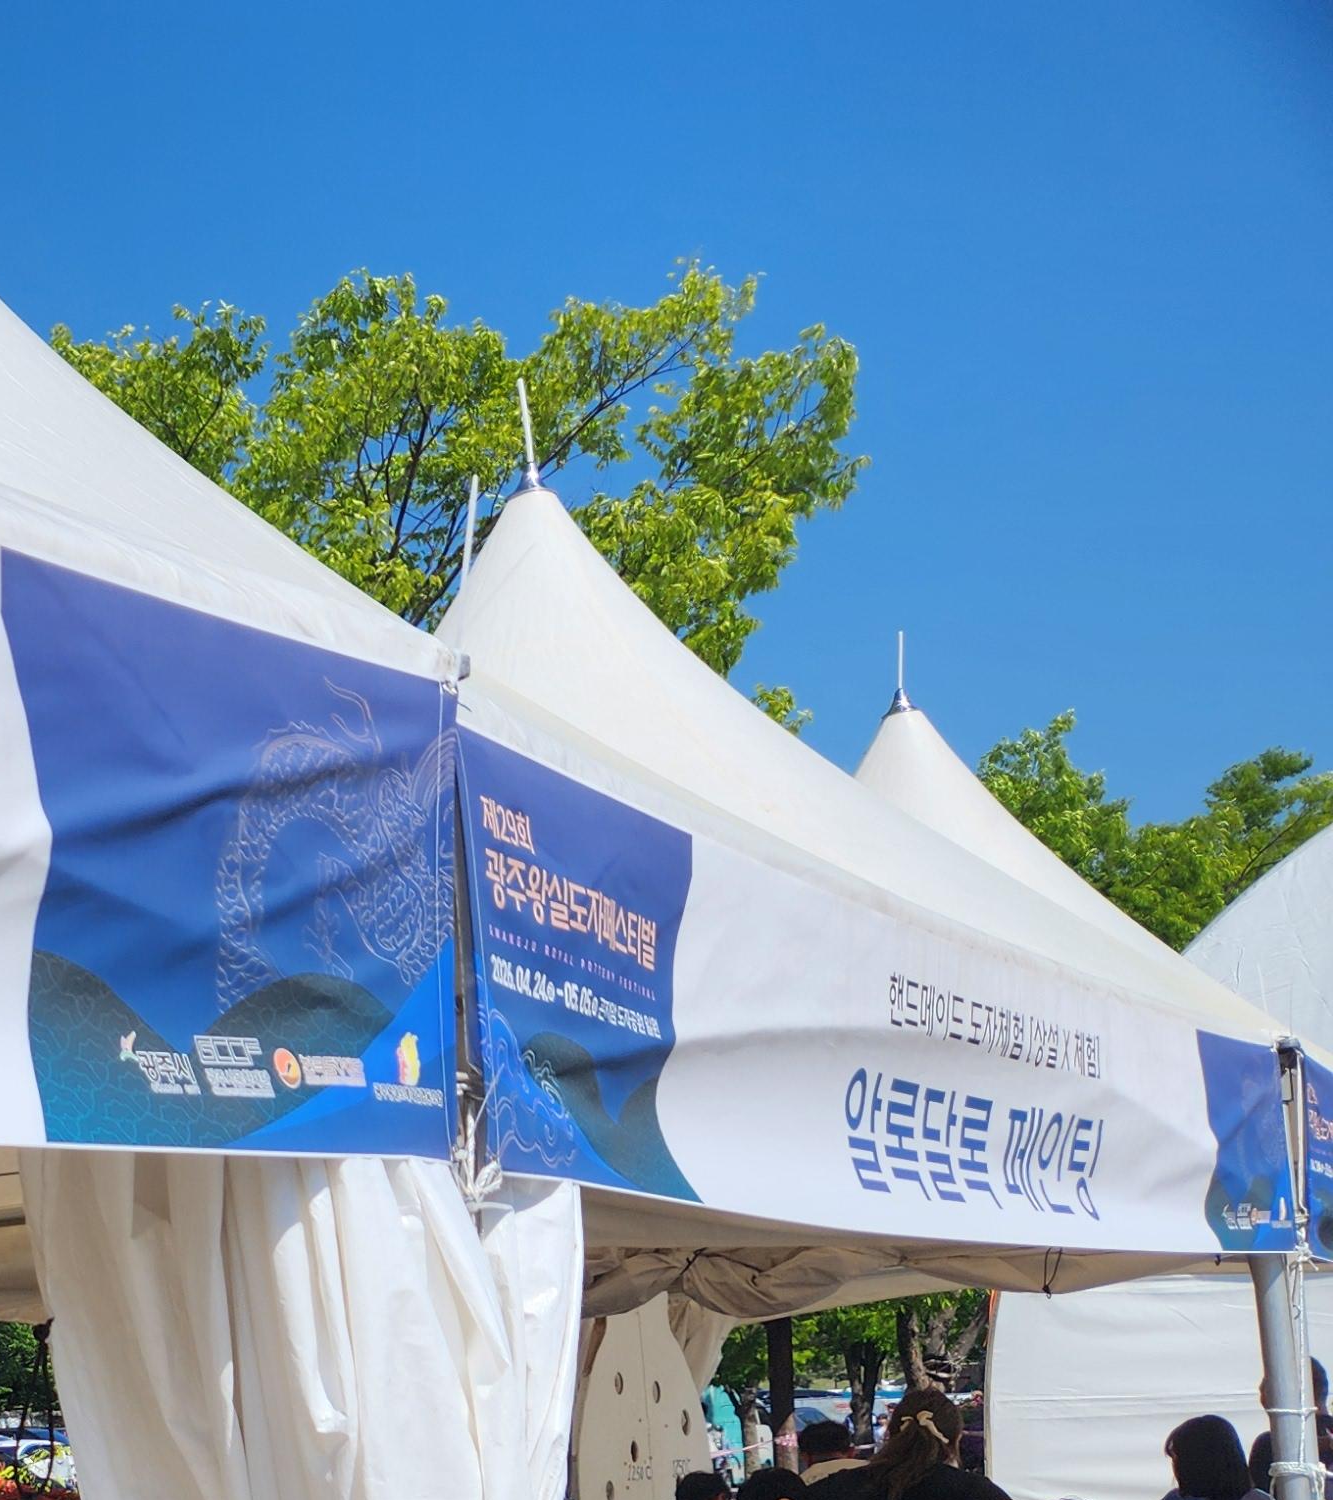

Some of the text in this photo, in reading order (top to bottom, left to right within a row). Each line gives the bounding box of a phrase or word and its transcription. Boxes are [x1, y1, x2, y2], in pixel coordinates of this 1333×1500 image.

[480, 795, 536, 856] 제29회
[485, 848, 657, 971] 광주왕실도자페스티벌
[135, 1050, 197, 1085] 광주시
[889, 972, 1101, 1079] 핸드메이드 도자체험 [상설 X 체험]
[845, 1067, 1104, 1221] 알록달록 페인팅
